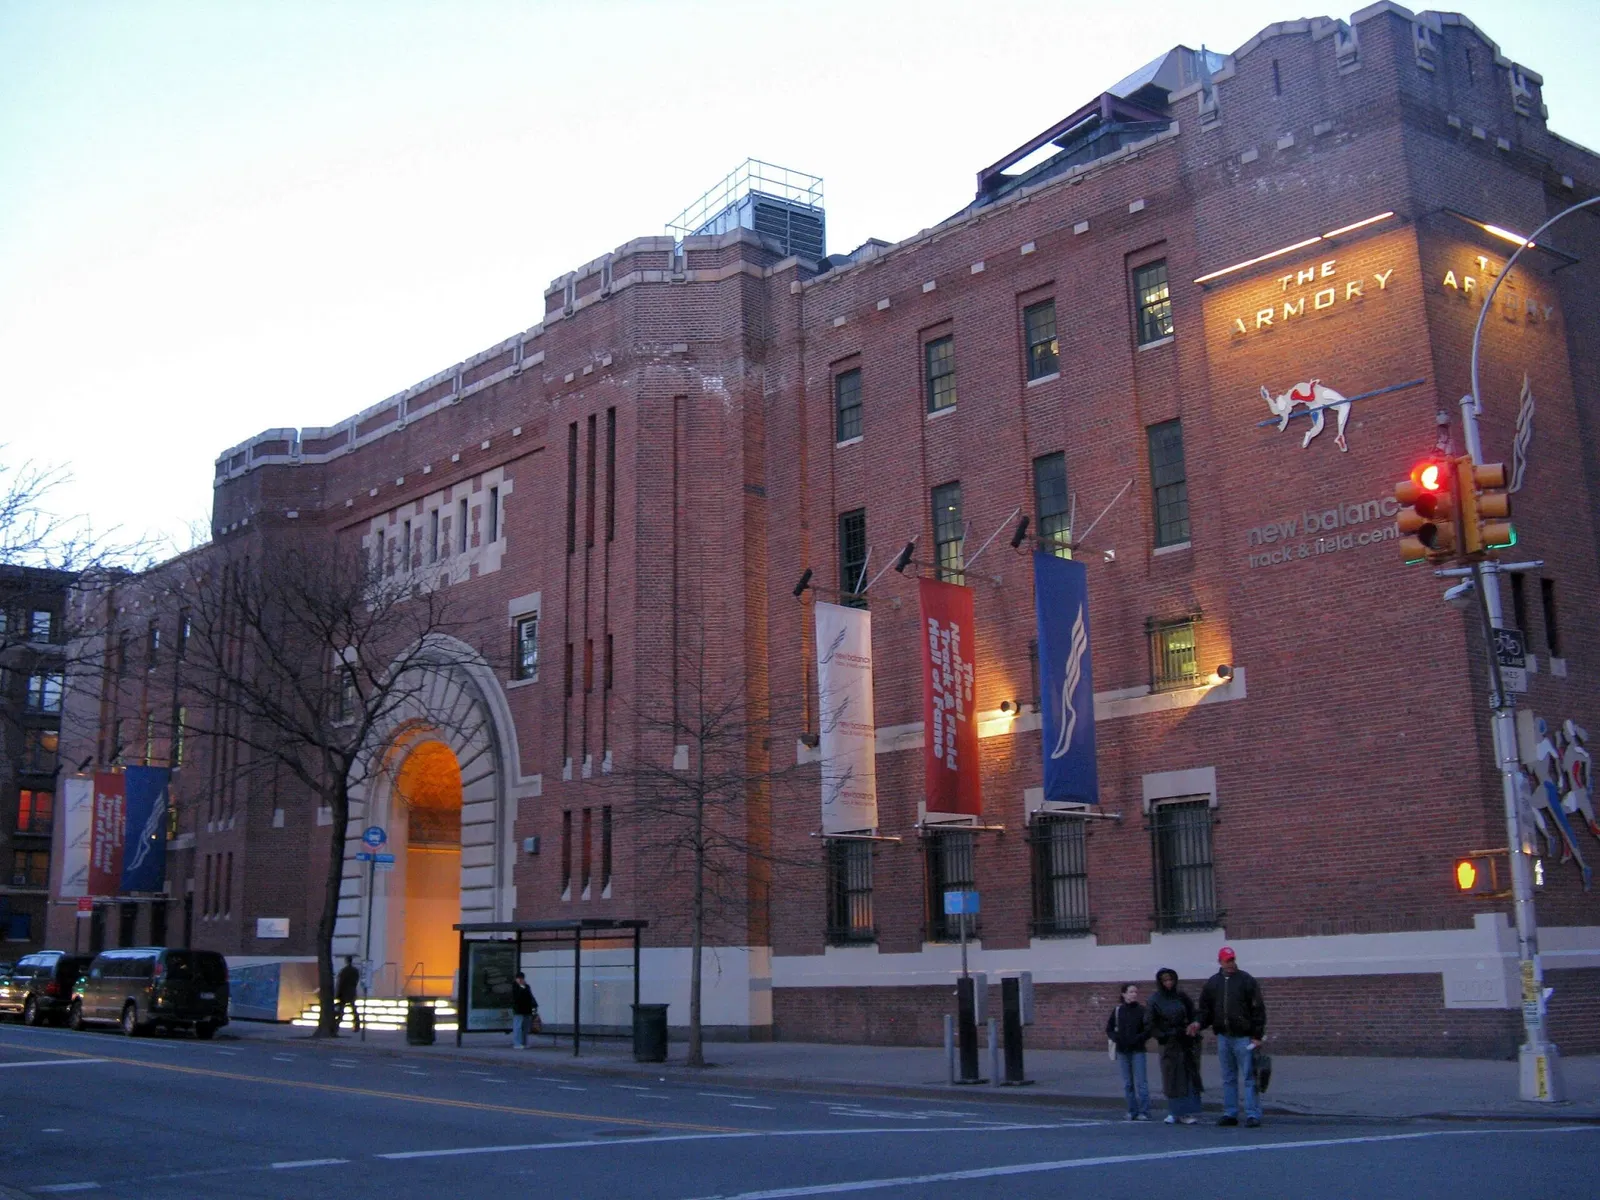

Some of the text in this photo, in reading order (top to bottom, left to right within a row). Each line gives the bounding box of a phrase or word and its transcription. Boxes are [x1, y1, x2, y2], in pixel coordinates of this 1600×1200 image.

[1229, 268, 1393, 339] ARMORY
[1277, 260, 1336, 291] THE
[1247, 496, 1401, 546] new balanc
[1249, 522, 1400, 568] track & field cent
[928, 617, 944, 759] Hall of Fame
[940, 629, 958, 771] Track & Field
[949, 621, 966, 722] National
[963, 662, 974, 701] The
